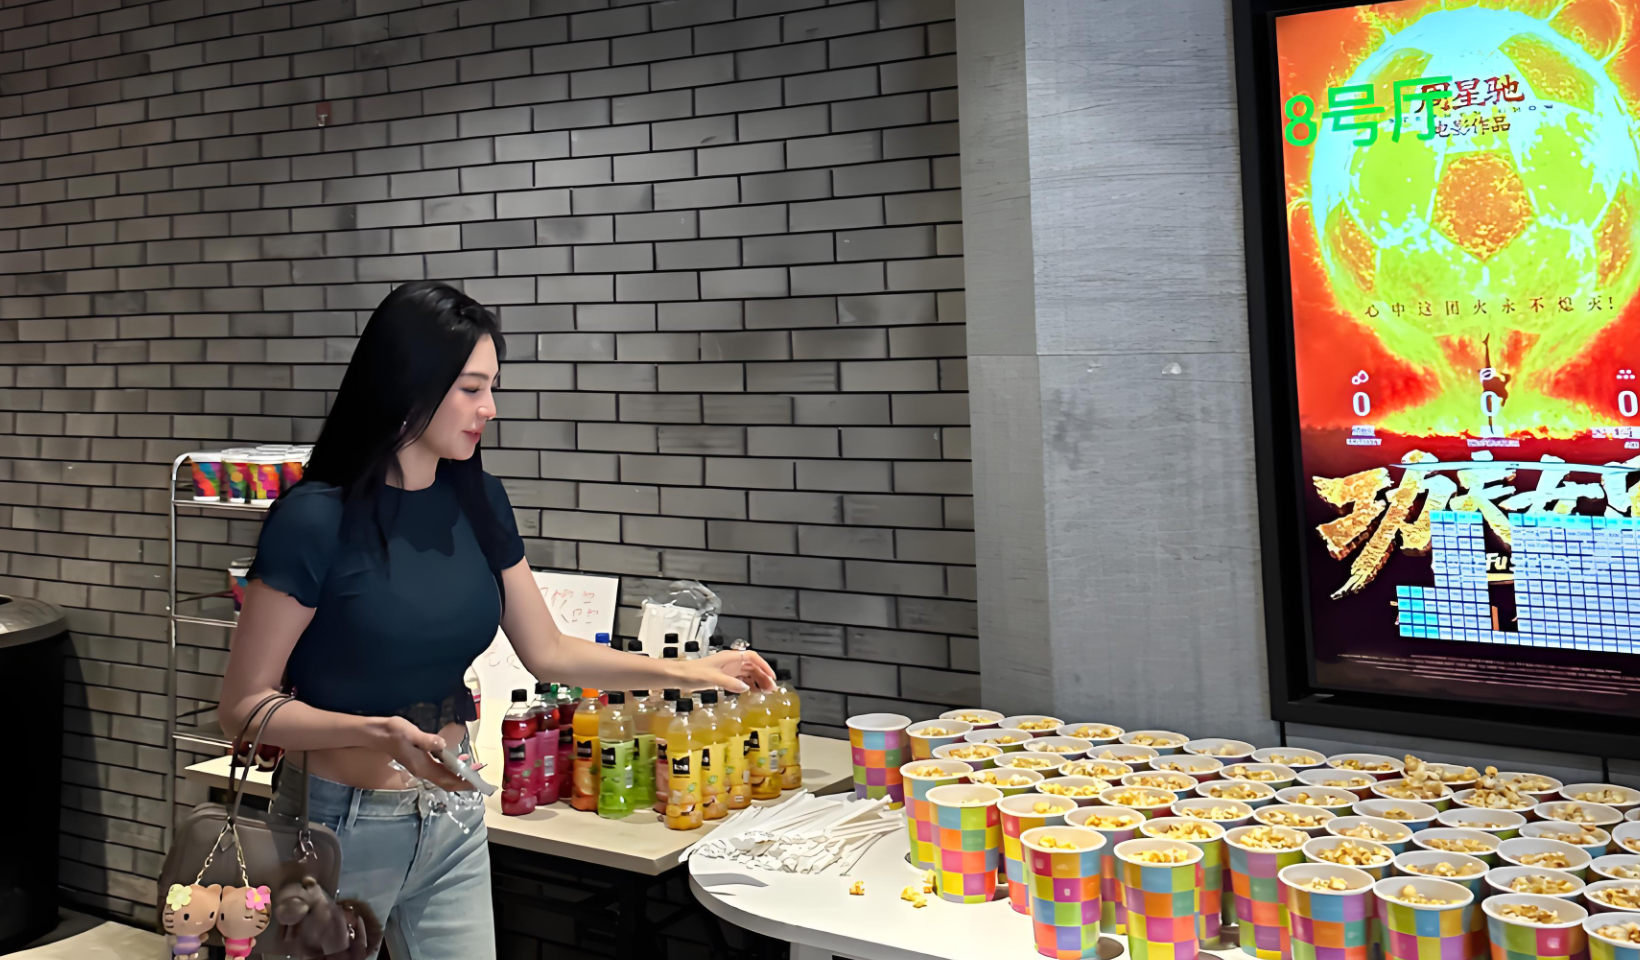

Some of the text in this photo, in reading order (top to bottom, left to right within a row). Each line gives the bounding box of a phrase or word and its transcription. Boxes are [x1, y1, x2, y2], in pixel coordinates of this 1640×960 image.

[1414, 74, 1525, 113] 周星驰
[1284, 76, 1453, 147] 8号厅
[1352, 391, 1371, 417] 0
[1481, 391, 1498, 416] 0
[1618, 390, 1639, 417] 0
